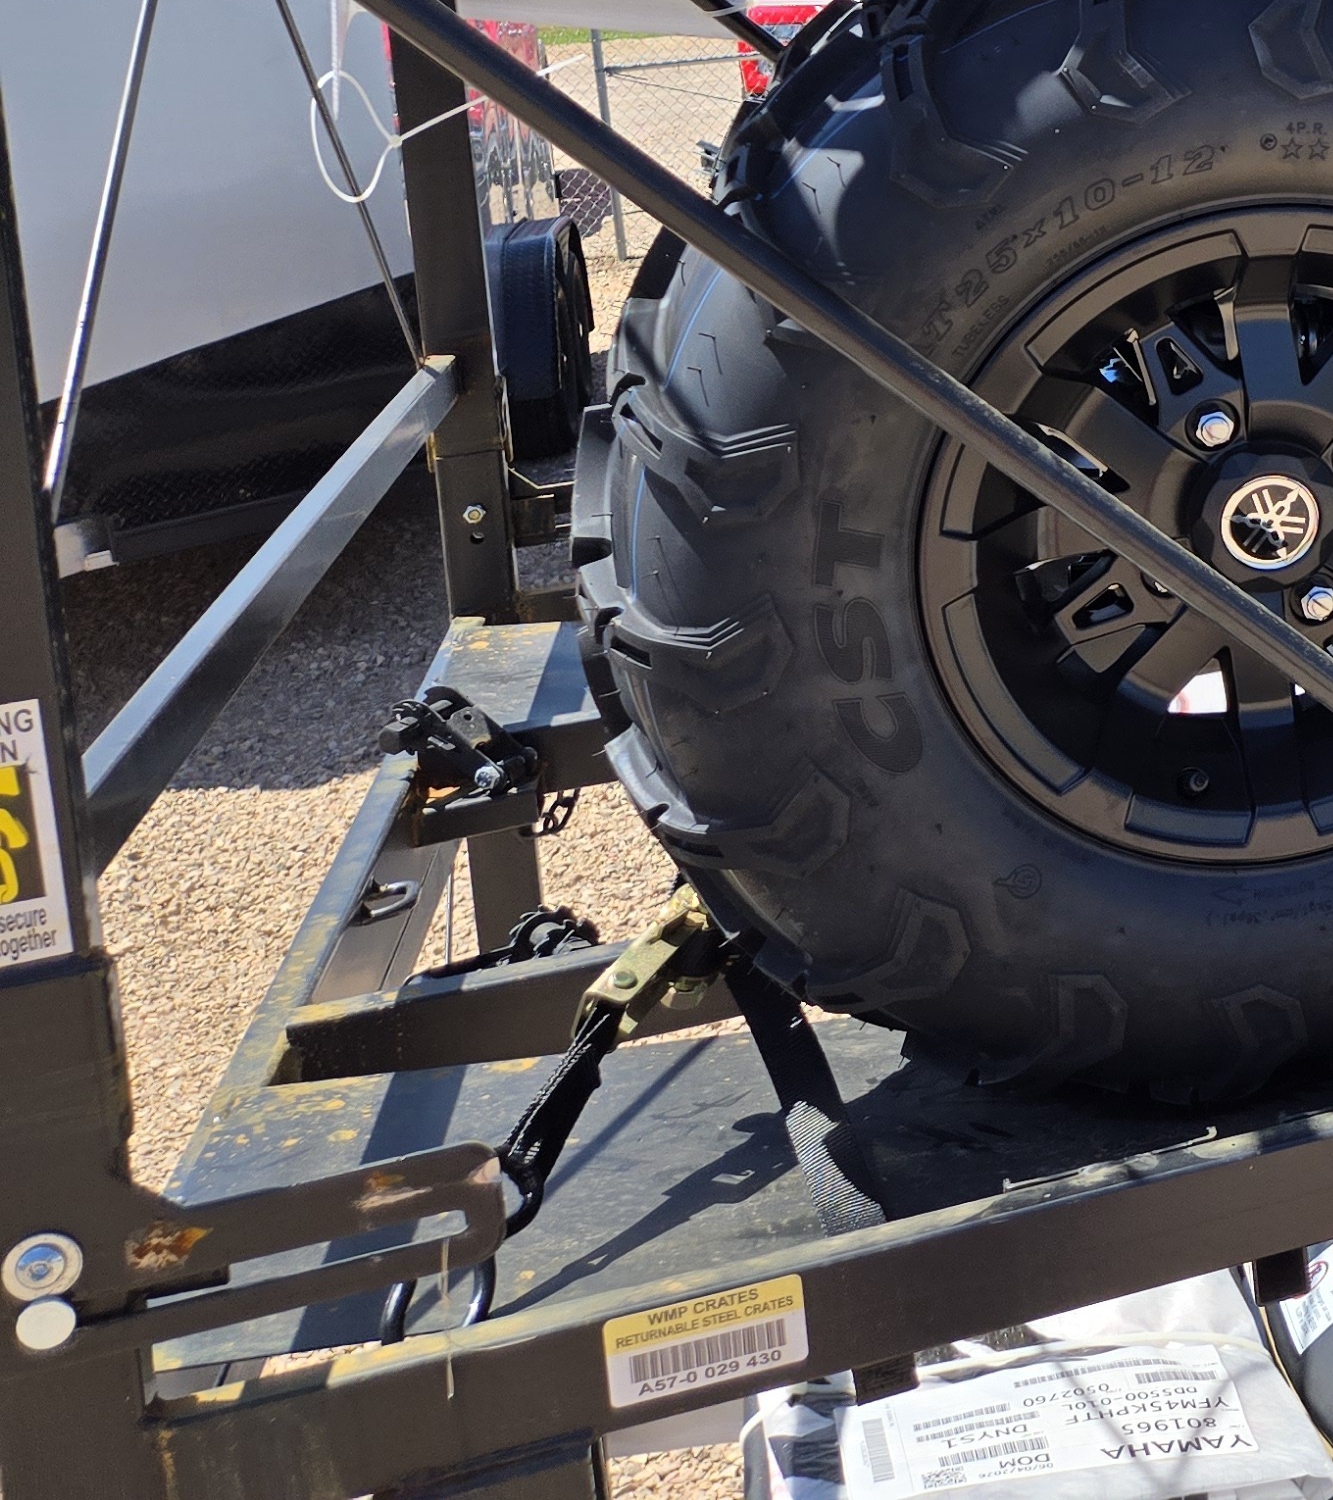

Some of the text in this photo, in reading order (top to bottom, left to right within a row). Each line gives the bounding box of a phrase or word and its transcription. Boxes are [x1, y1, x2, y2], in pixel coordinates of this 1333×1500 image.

[811, 497, 924, 776] CST
[647, 1288, 759, 1326] WMP CRATES
[616, 1295, 794, 1349] RETURNABLE STEEL CRATES
[638, 1349, 782, 1397] A57-0 029 430
[1023, 1382, 1110, 1408] 0502760
[1061, 1385, 1198, 1412] DD5500-010L
[1064, 1396, 1230, 1425] YFM45KPHTF
[1121, 1416, 1218, 1436] 801965
[998, 1452, 1051, 1469] DOM
[1100, 1433, 1253, 1461] YAMAHA
